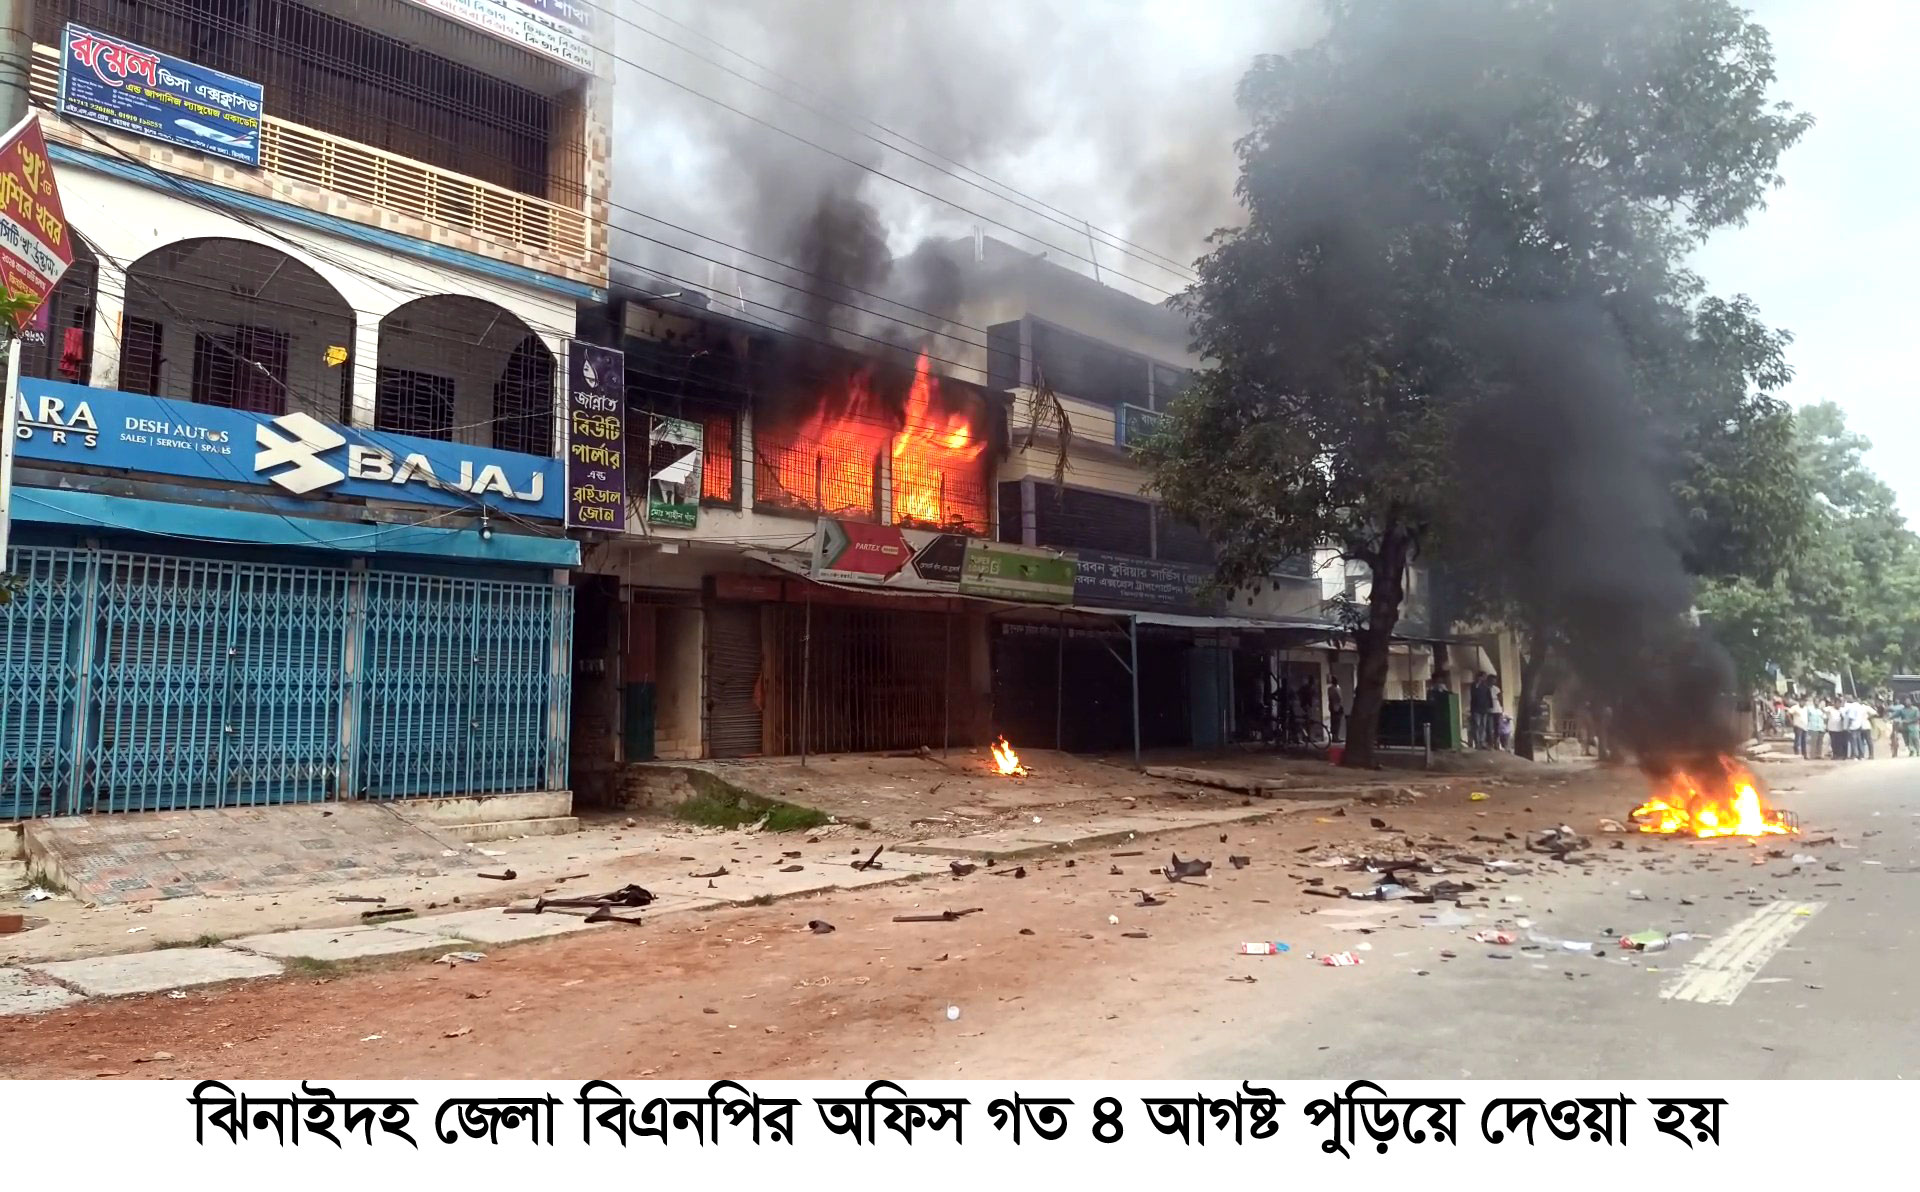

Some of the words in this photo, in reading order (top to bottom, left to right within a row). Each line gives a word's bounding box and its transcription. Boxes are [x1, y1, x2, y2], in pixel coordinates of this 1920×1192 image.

[69, 31, 160, 87] রয়েল
[158, 70, 191, 93] ভিসা
[35, 201, 63, 247] খবর
[573, 391, 618, 412] জান্নাত
[125, 416, 169, 435] DESH
[173, 424, 229, 443] AUTS
[572, 410, 621, 441] বিউটি
[120, 432, 147, 444] SALES
[156, 438, 192, 449] SERVICE
[201, 443, 232, 455] SPAES
[571, 442, 621, 469] পার্লার
[348, 444, 544, 502] BAJAJ
[572, 484, 622, 505] ব্রাইডাল
[578, 505, 615, 522] জোন
[855, 542, 880, 552] PARTEX
[1109, 563, 1147, 578] কুরিয়ার
